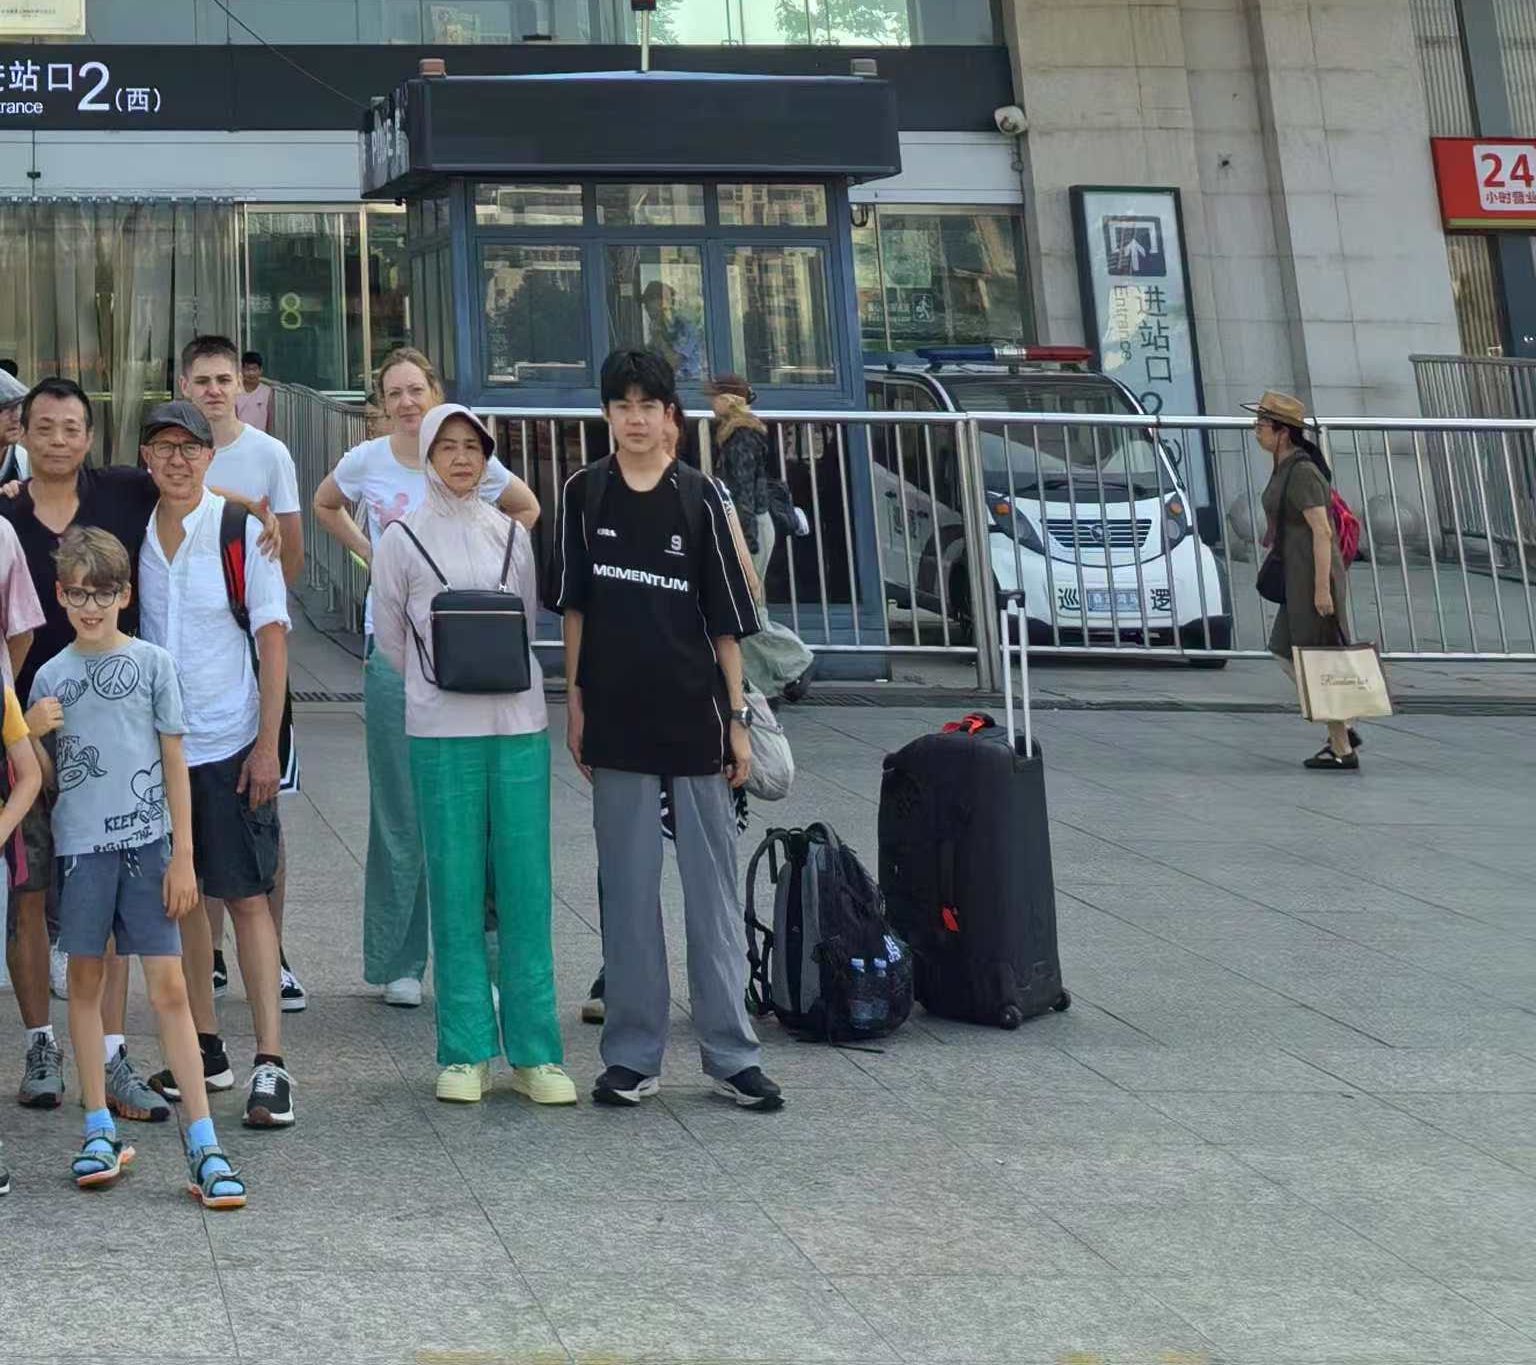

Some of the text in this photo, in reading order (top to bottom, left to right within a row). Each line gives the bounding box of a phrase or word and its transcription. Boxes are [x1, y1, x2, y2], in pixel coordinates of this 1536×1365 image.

[1480, 153, 1535, 188] 24
[1113, 284, 1132, 361] Entrance
[593, 563, 689, 592] MOMENTUM
[104, 810, 139, 833] KEEP
